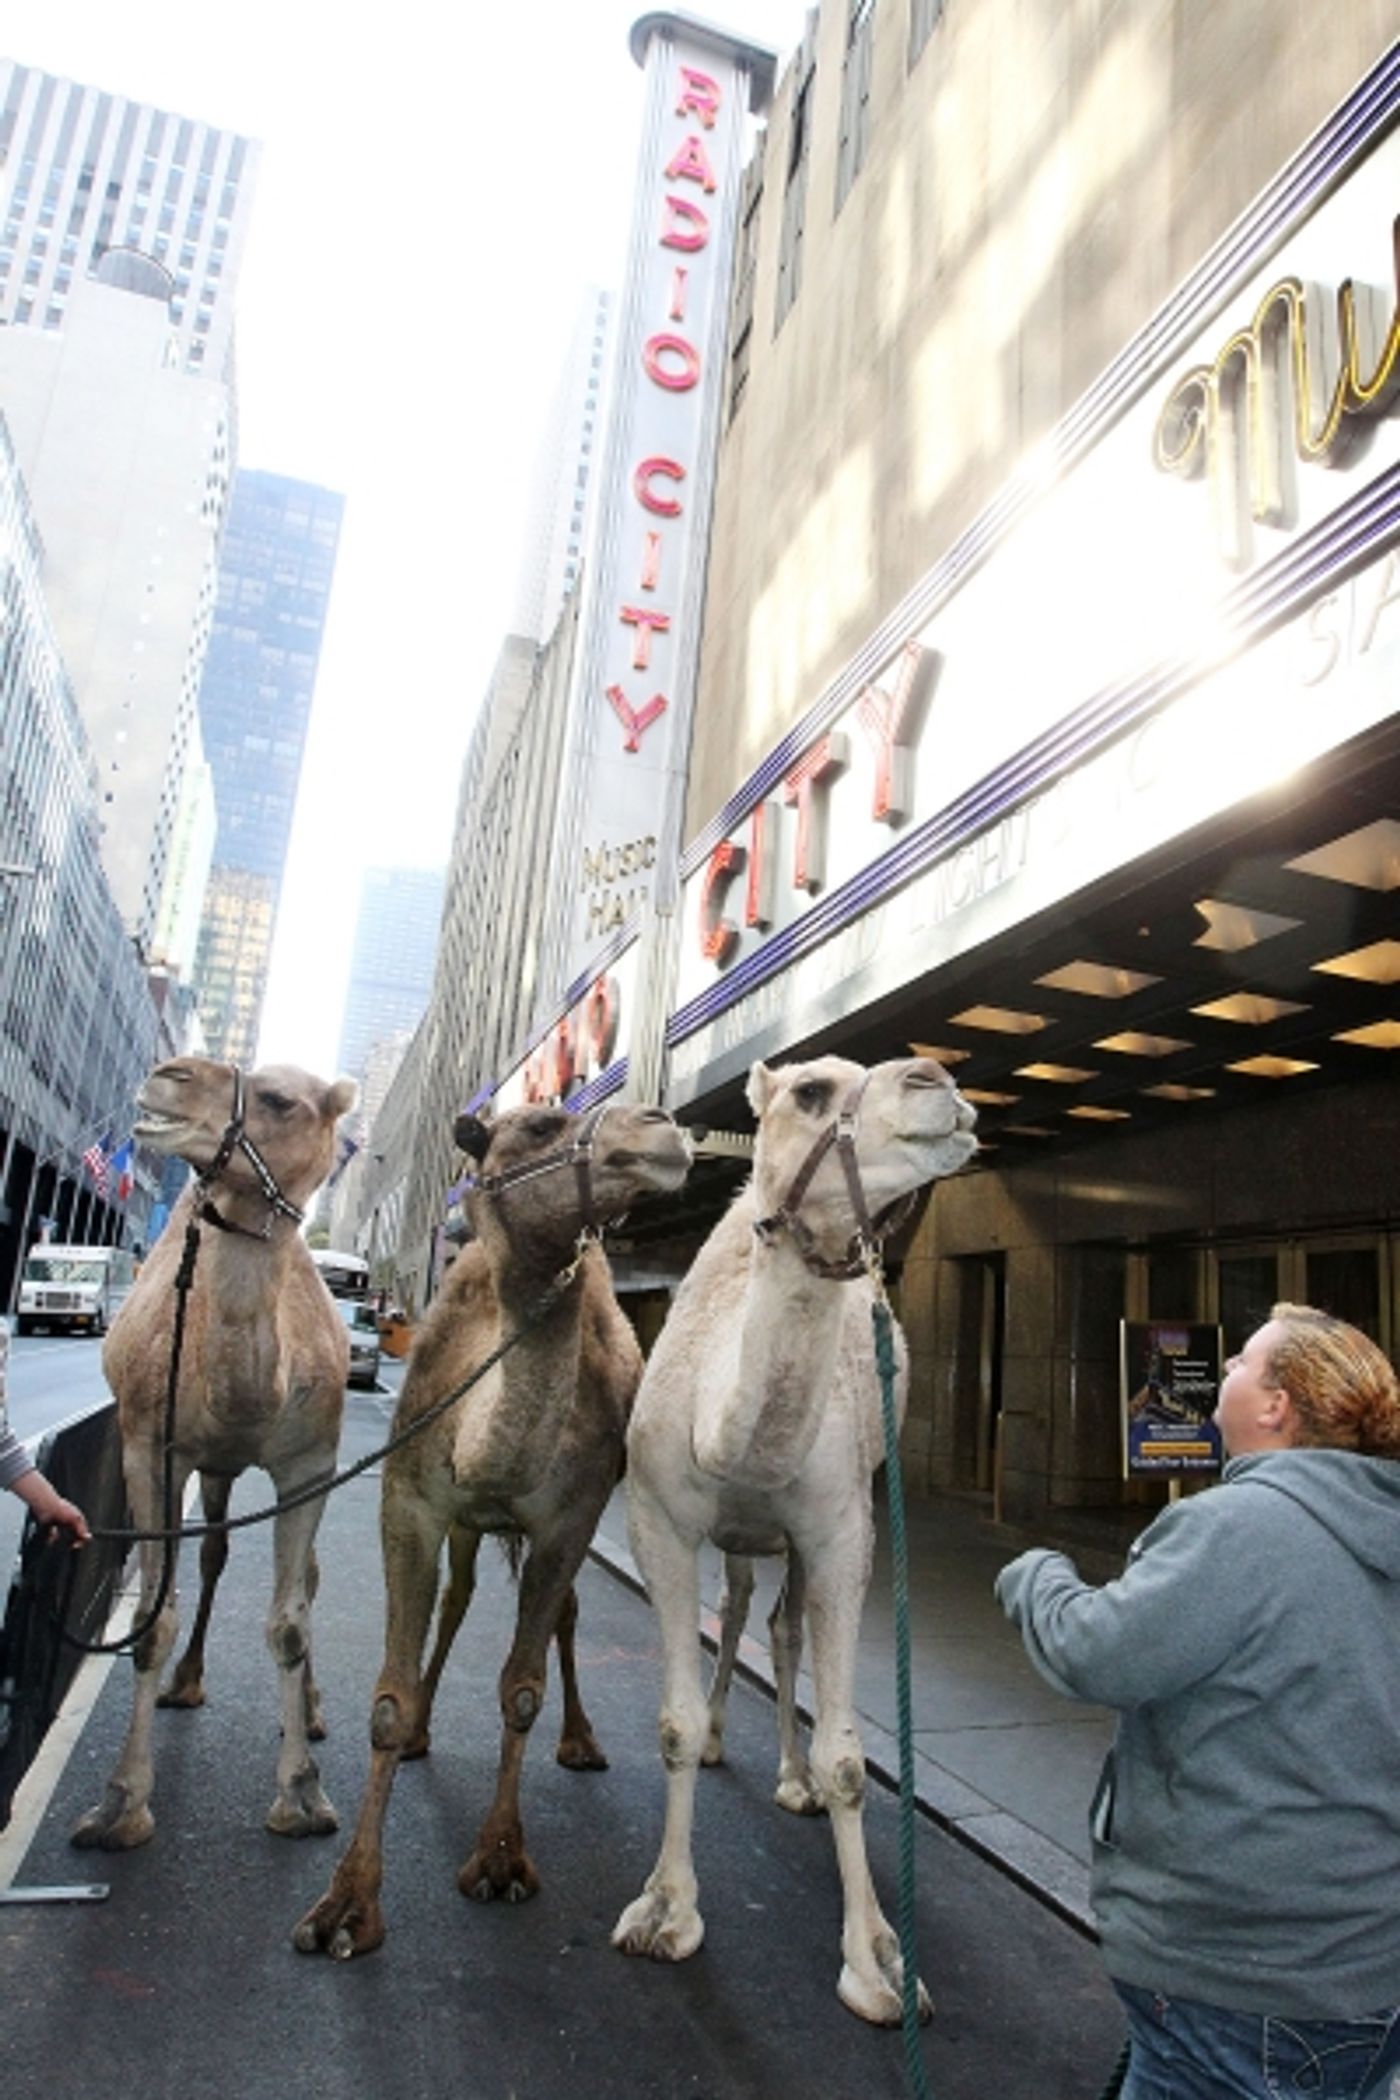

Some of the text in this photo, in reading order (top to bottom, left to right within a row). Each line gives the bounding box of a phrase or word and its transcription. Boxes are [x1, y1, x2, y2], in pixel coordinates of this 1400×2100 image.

[604, 65, 723, 755] RADIO CITY
[580, 834, 658, 894] MUSIC
[699, 637, 945, 970] CITY
